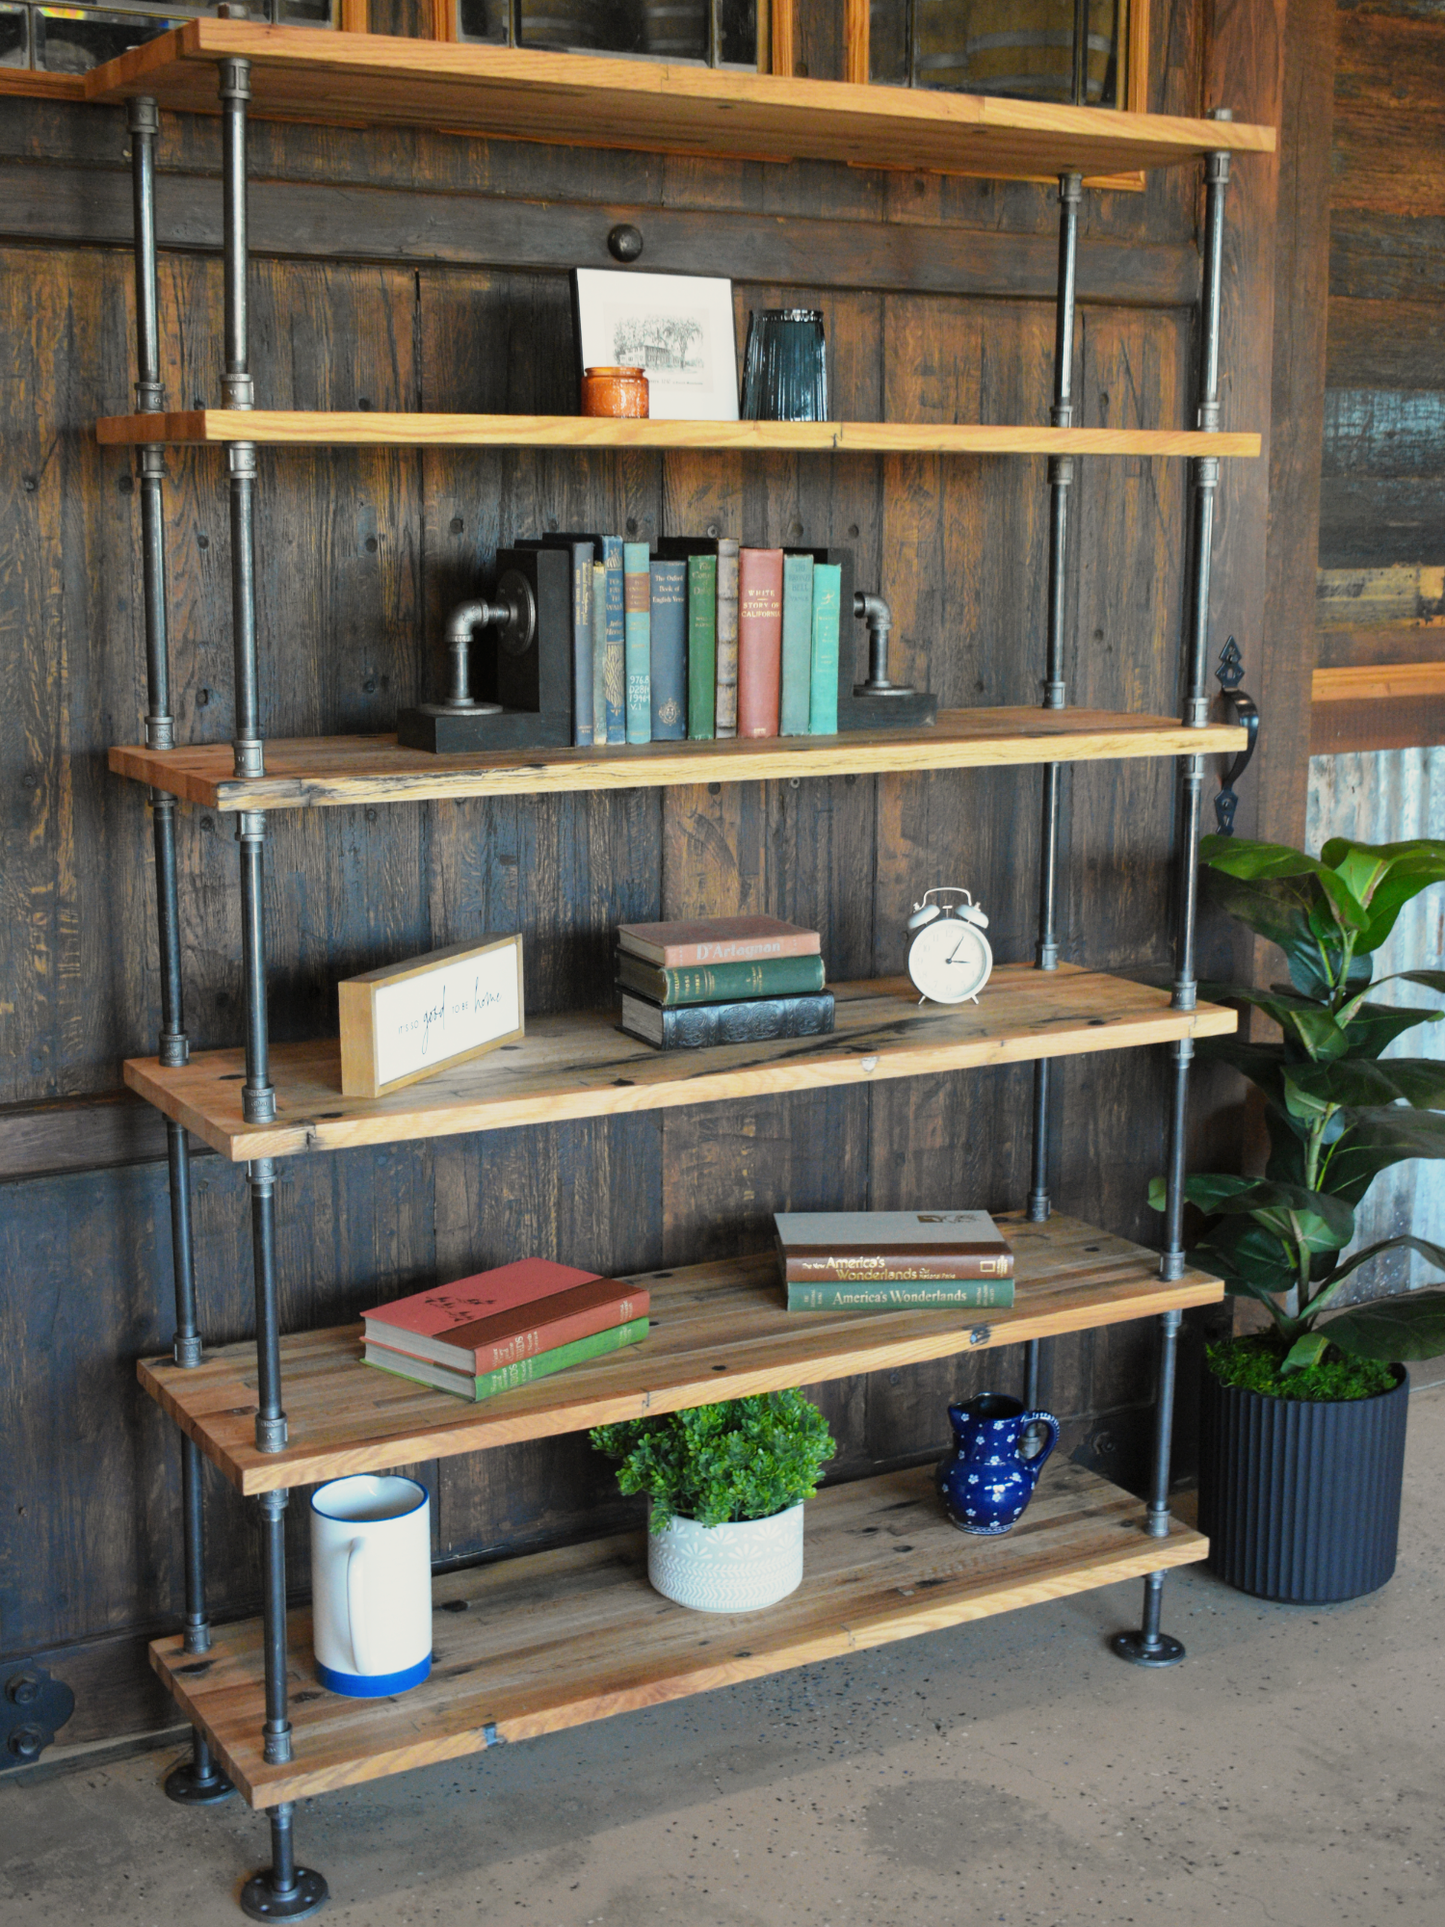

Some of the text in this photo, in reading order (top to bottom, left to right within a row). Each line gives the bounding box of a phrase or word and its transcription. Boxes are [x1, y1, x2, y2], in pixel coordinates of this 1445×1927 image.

[696, 941, 781, 961] D'Artagnan
[398, 976, 502, 1055] IT'S SO good TO BE home
[826, 1256, 886, 1269] America's
[836, 1268, 918, 1280] Wonderlands
[832, 1291, 888, 1305] America's
[889, 1289, 967, 1303] Wonderlands
